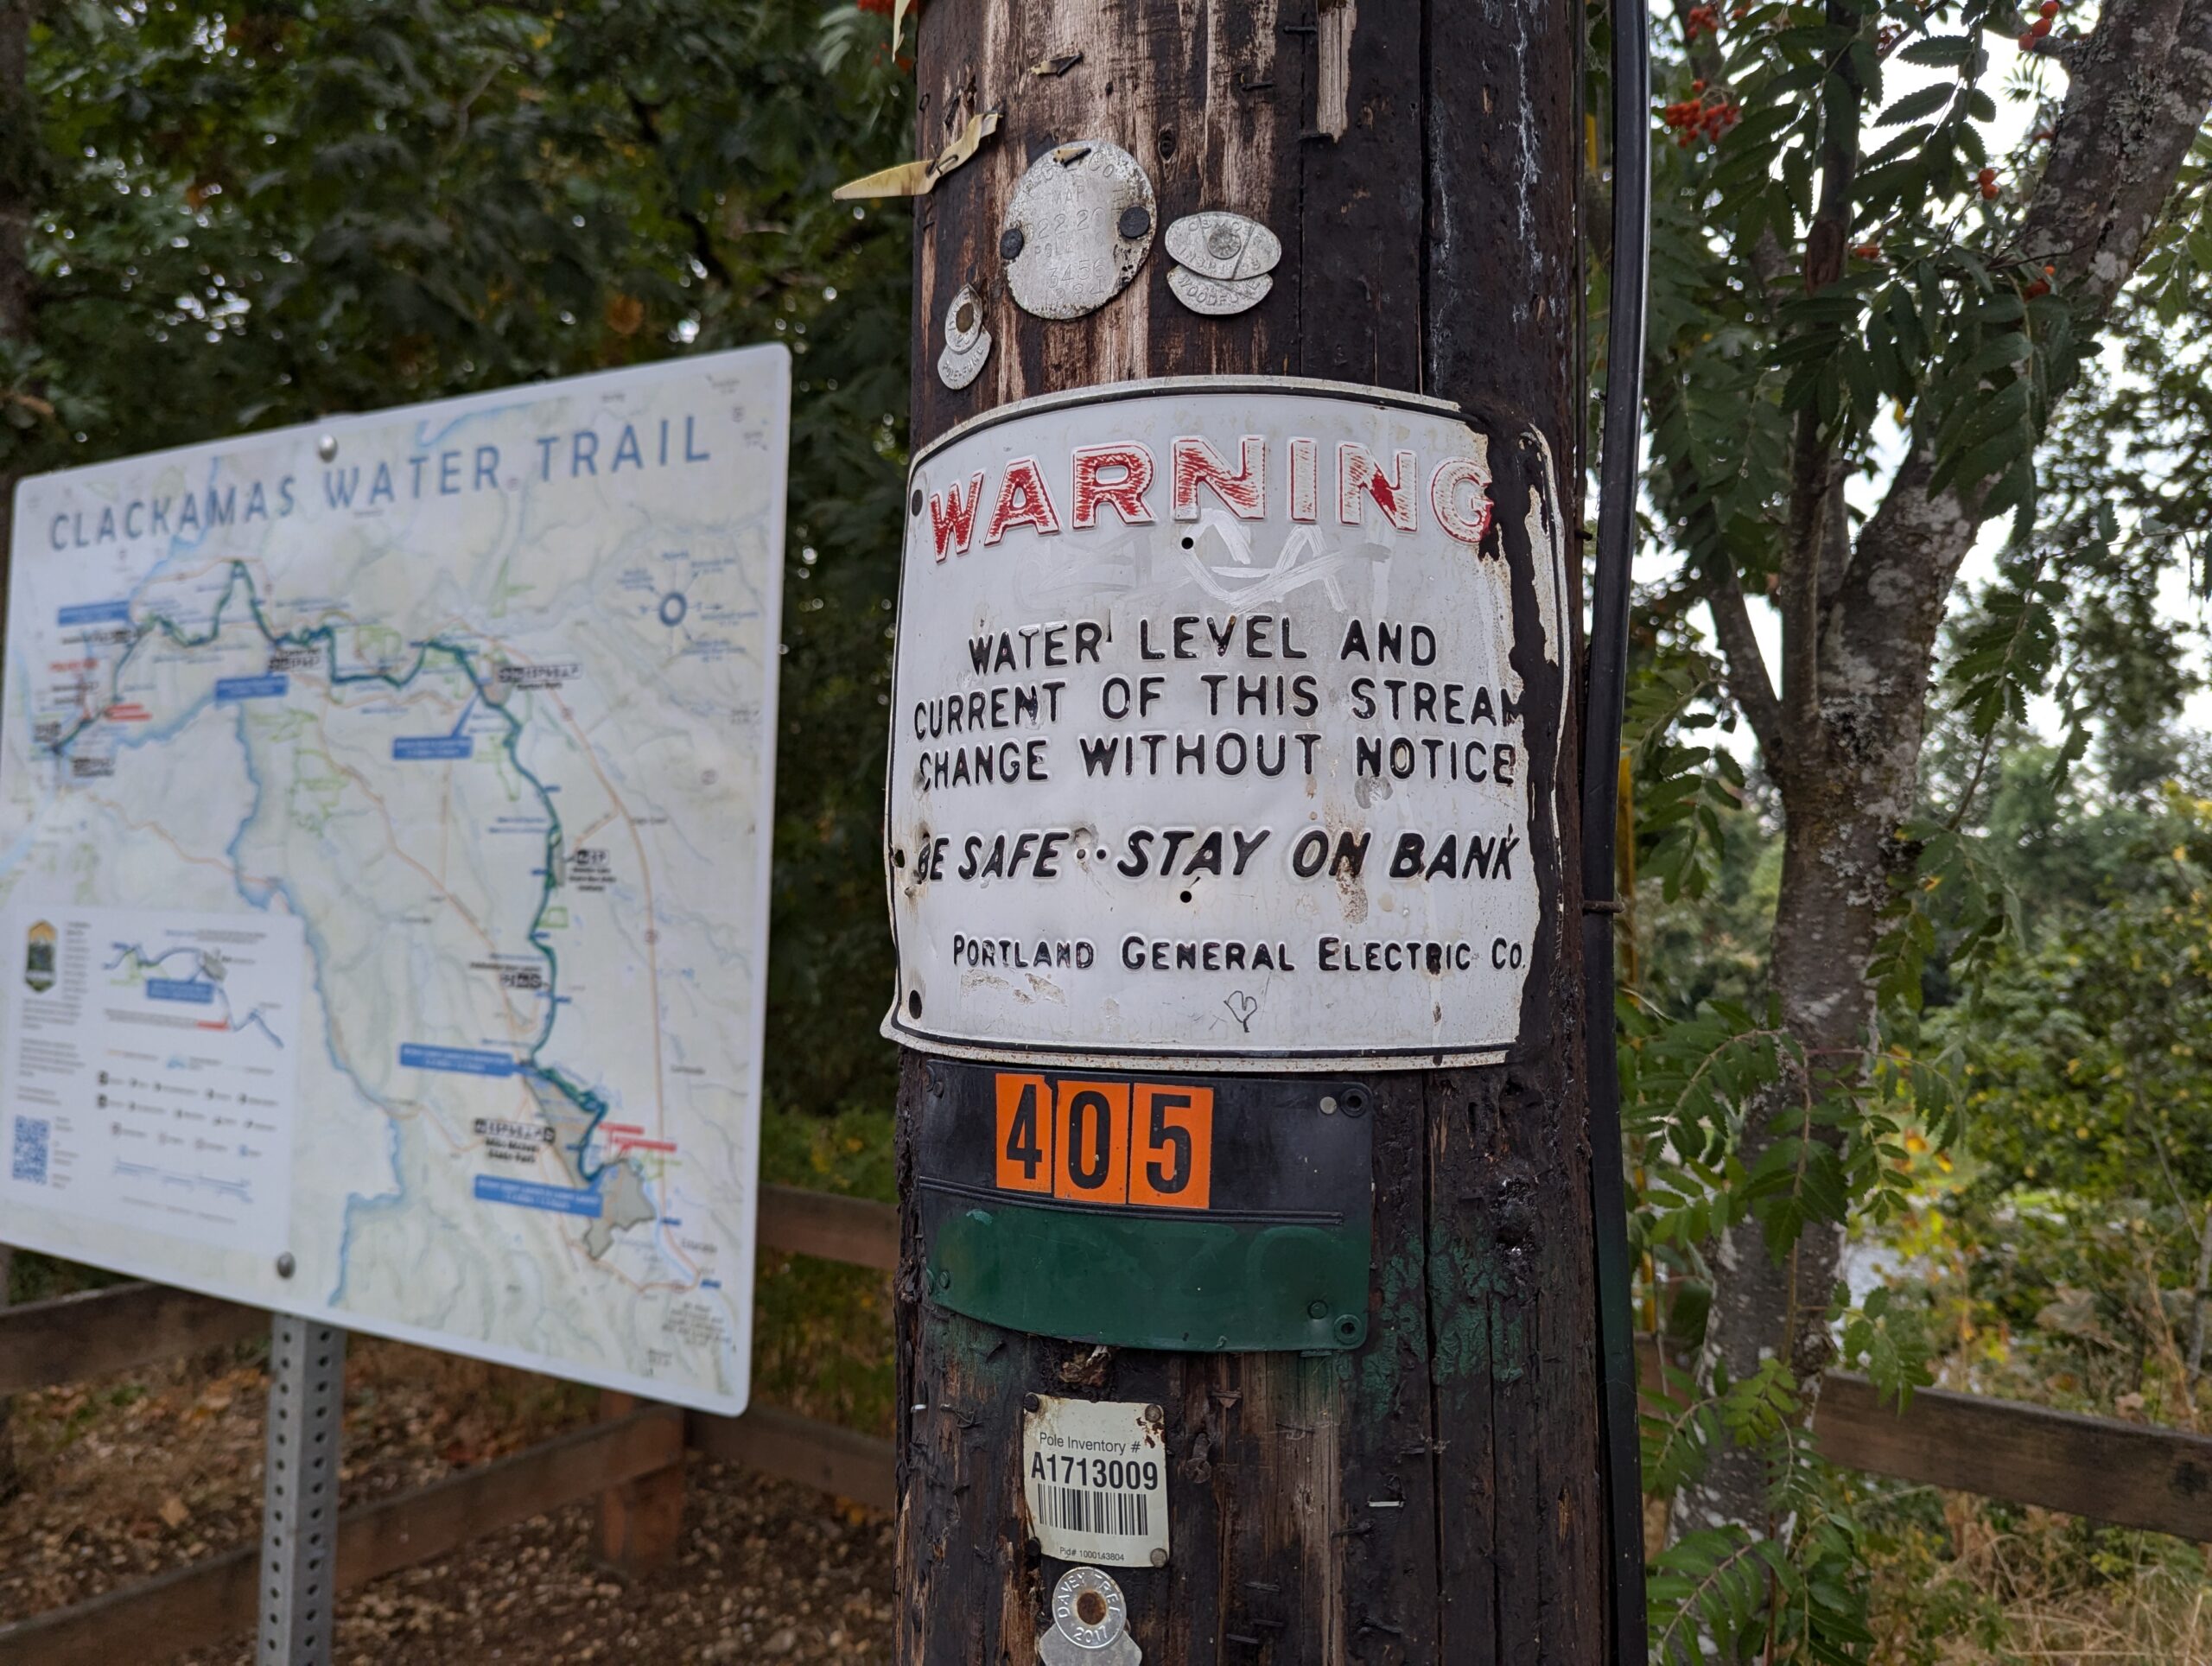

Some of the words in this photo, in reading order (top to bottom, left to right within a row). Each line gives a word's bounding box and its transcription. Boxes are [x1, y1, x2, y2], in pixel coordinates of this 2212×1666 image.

[50, 475, 296, 553] CLACKAMAS
[323, 445, 503, 510] WATER
[534, 413, 713, 482] TRAIL
[929, 436, 1496, 563] WARNING
[968, 624, 1102, 676] WATER
[1140, 615, 1307, 660] LEVEL
[1341, 619, 1438, 667] AND
[914, 681, 1068, 740] CURRENT
[1102, 677, 1164, 720] OF
[1200, 675, 1319, 718] THIS
[919, 739, 1049, 790] CHANGE
[1079, 732, 1322, 777] WITHOUT
[1357, 737, 1516, 784] NOTICE
[957, 831, 1071, 879] SAFE
[1117, 829, 1271, 877] STAY
[1293, 831, 1371, 877] ON
[1389, 834, 1520, 881] BANK
[1006, 1084, 1192, 1194] 405
[1031, 1451, 1159, 1491] A1713009
[1039, 1431, 1065, 1447] Pole
[1068, 1435, 1126, 1456] Inventory
[1131, 1440, 1141, 1453] #
[1072, 1625, 1108, 1643] 2017
